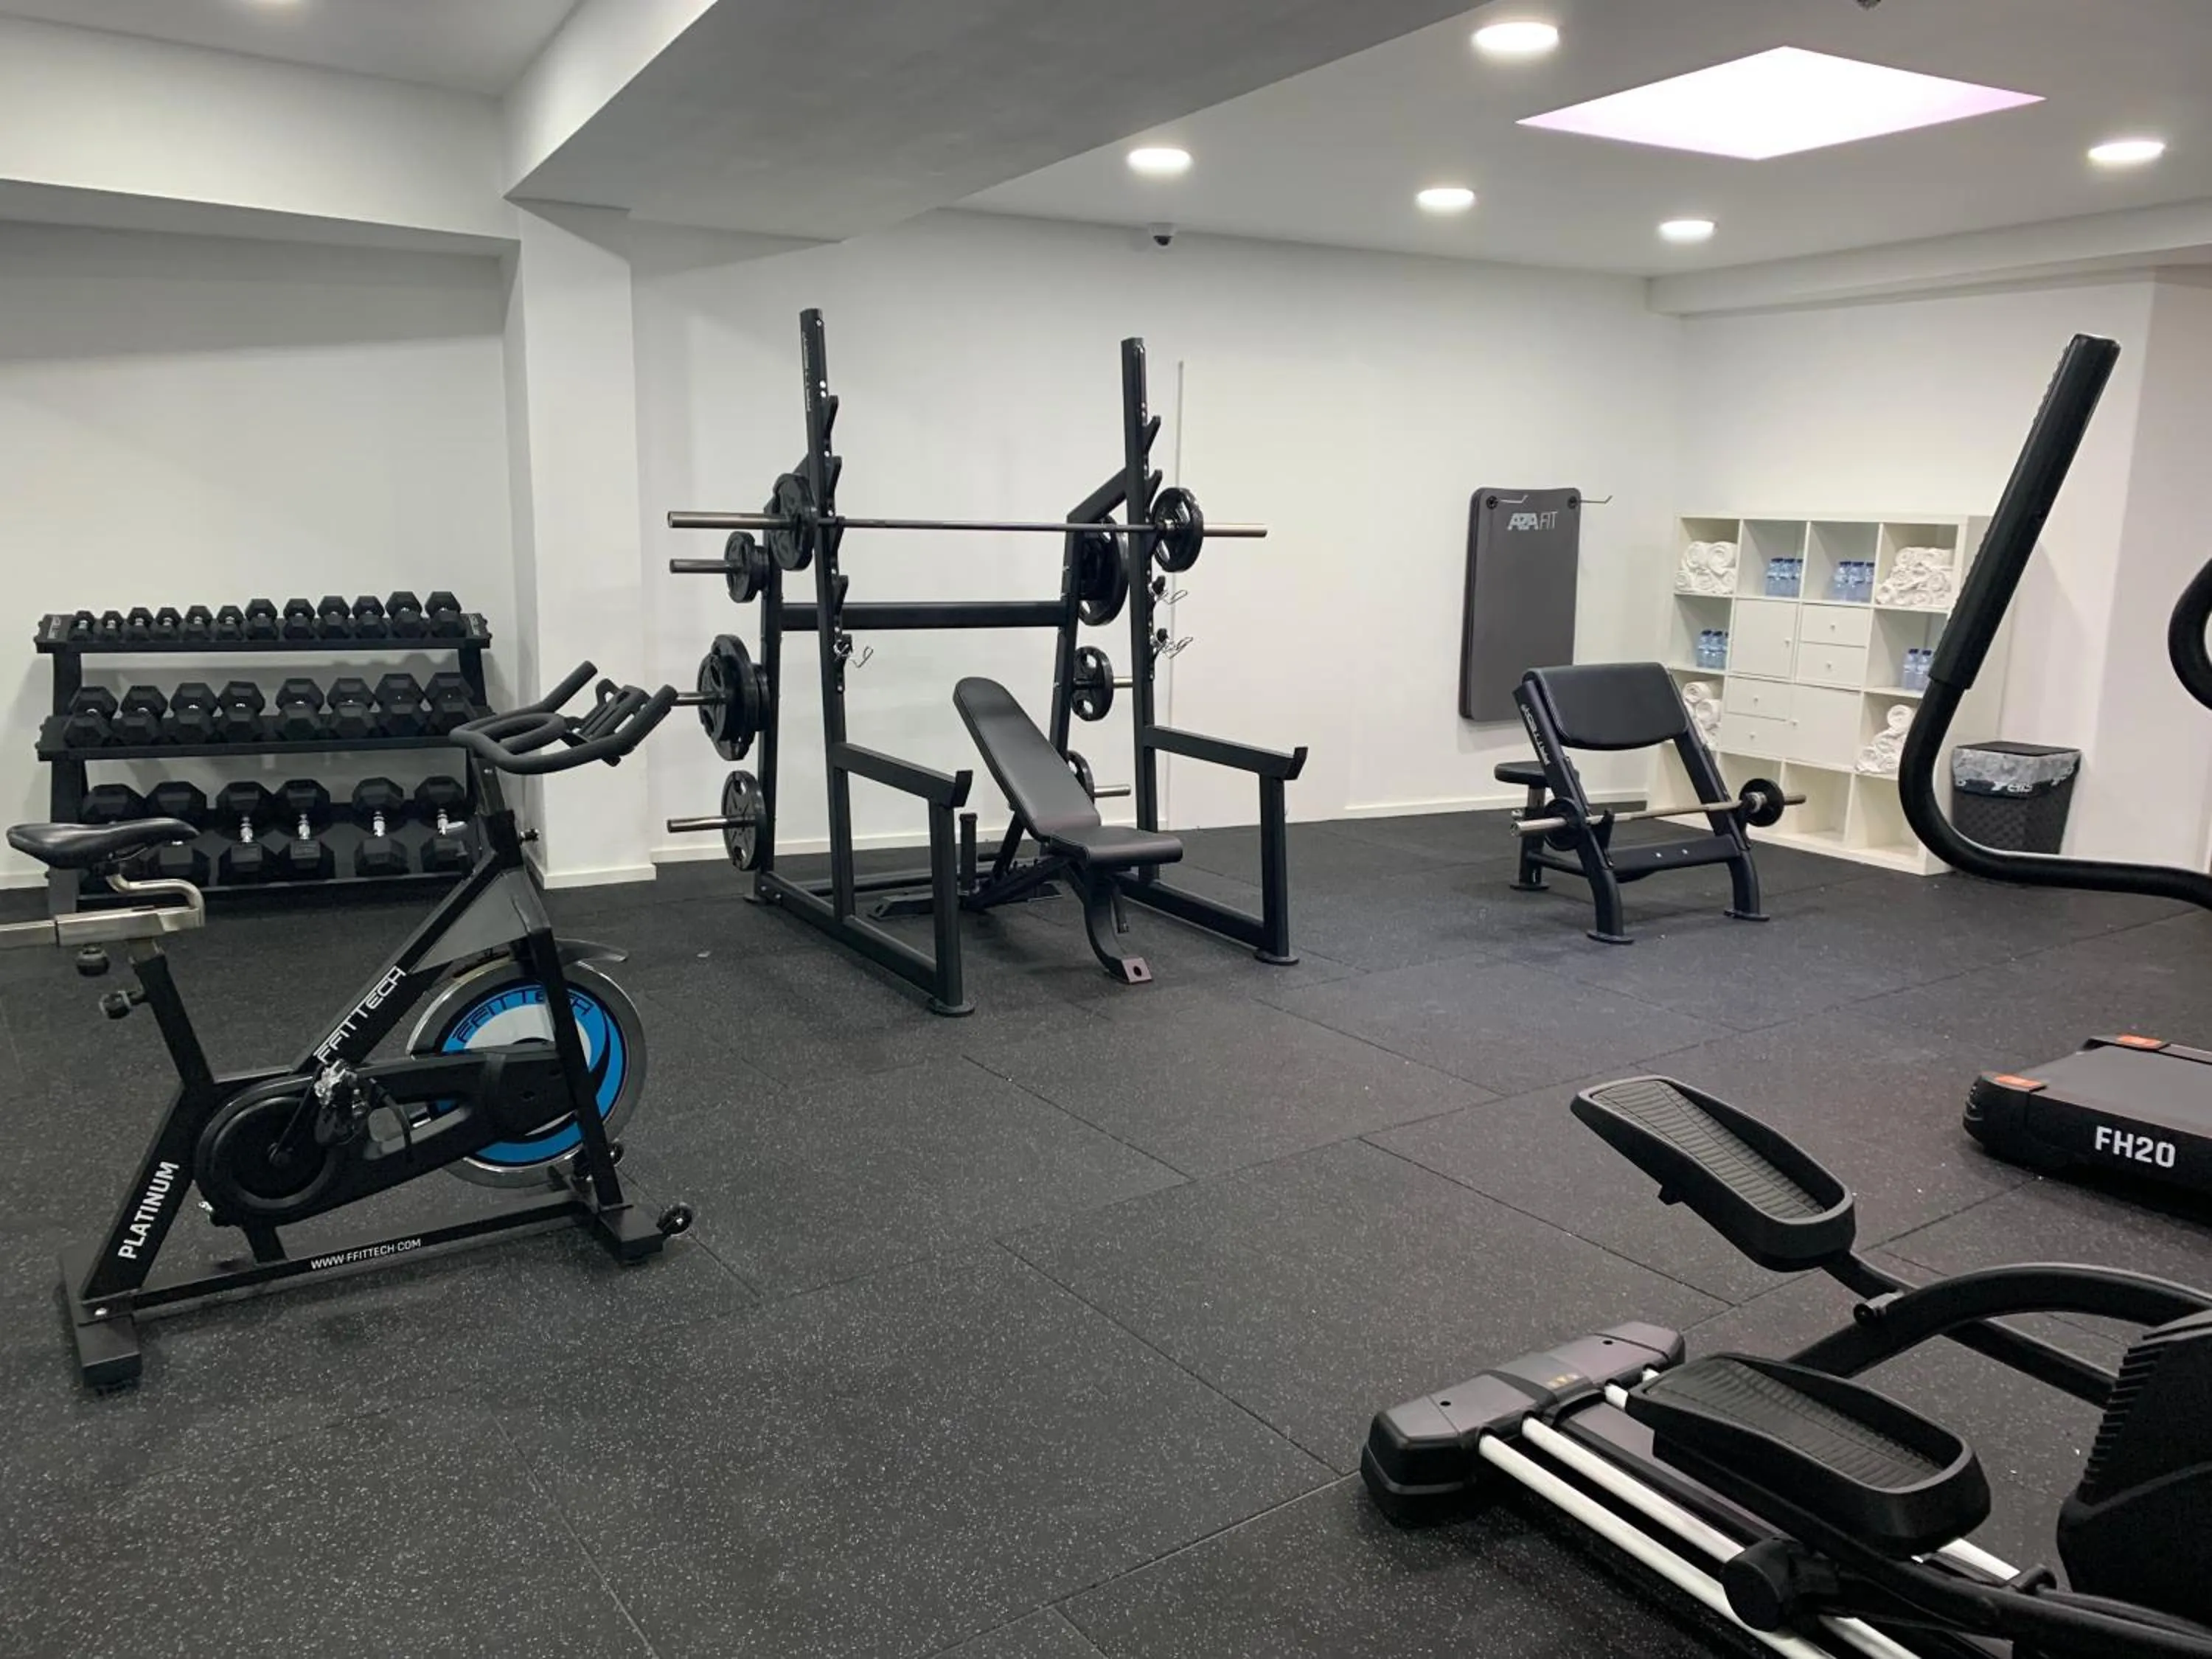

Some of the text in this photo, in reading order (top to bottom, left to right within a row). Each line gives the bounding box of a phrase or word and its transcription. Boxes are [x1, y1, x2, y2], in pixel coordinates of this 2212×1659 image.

[313, 965, 406, 1065] FFITTECH
[451, 986, 594, 1043] FFITTEH
[2095, 1125, 2176, 1168] FH20
[118, 1161, 179, 1259] PLATINUM
